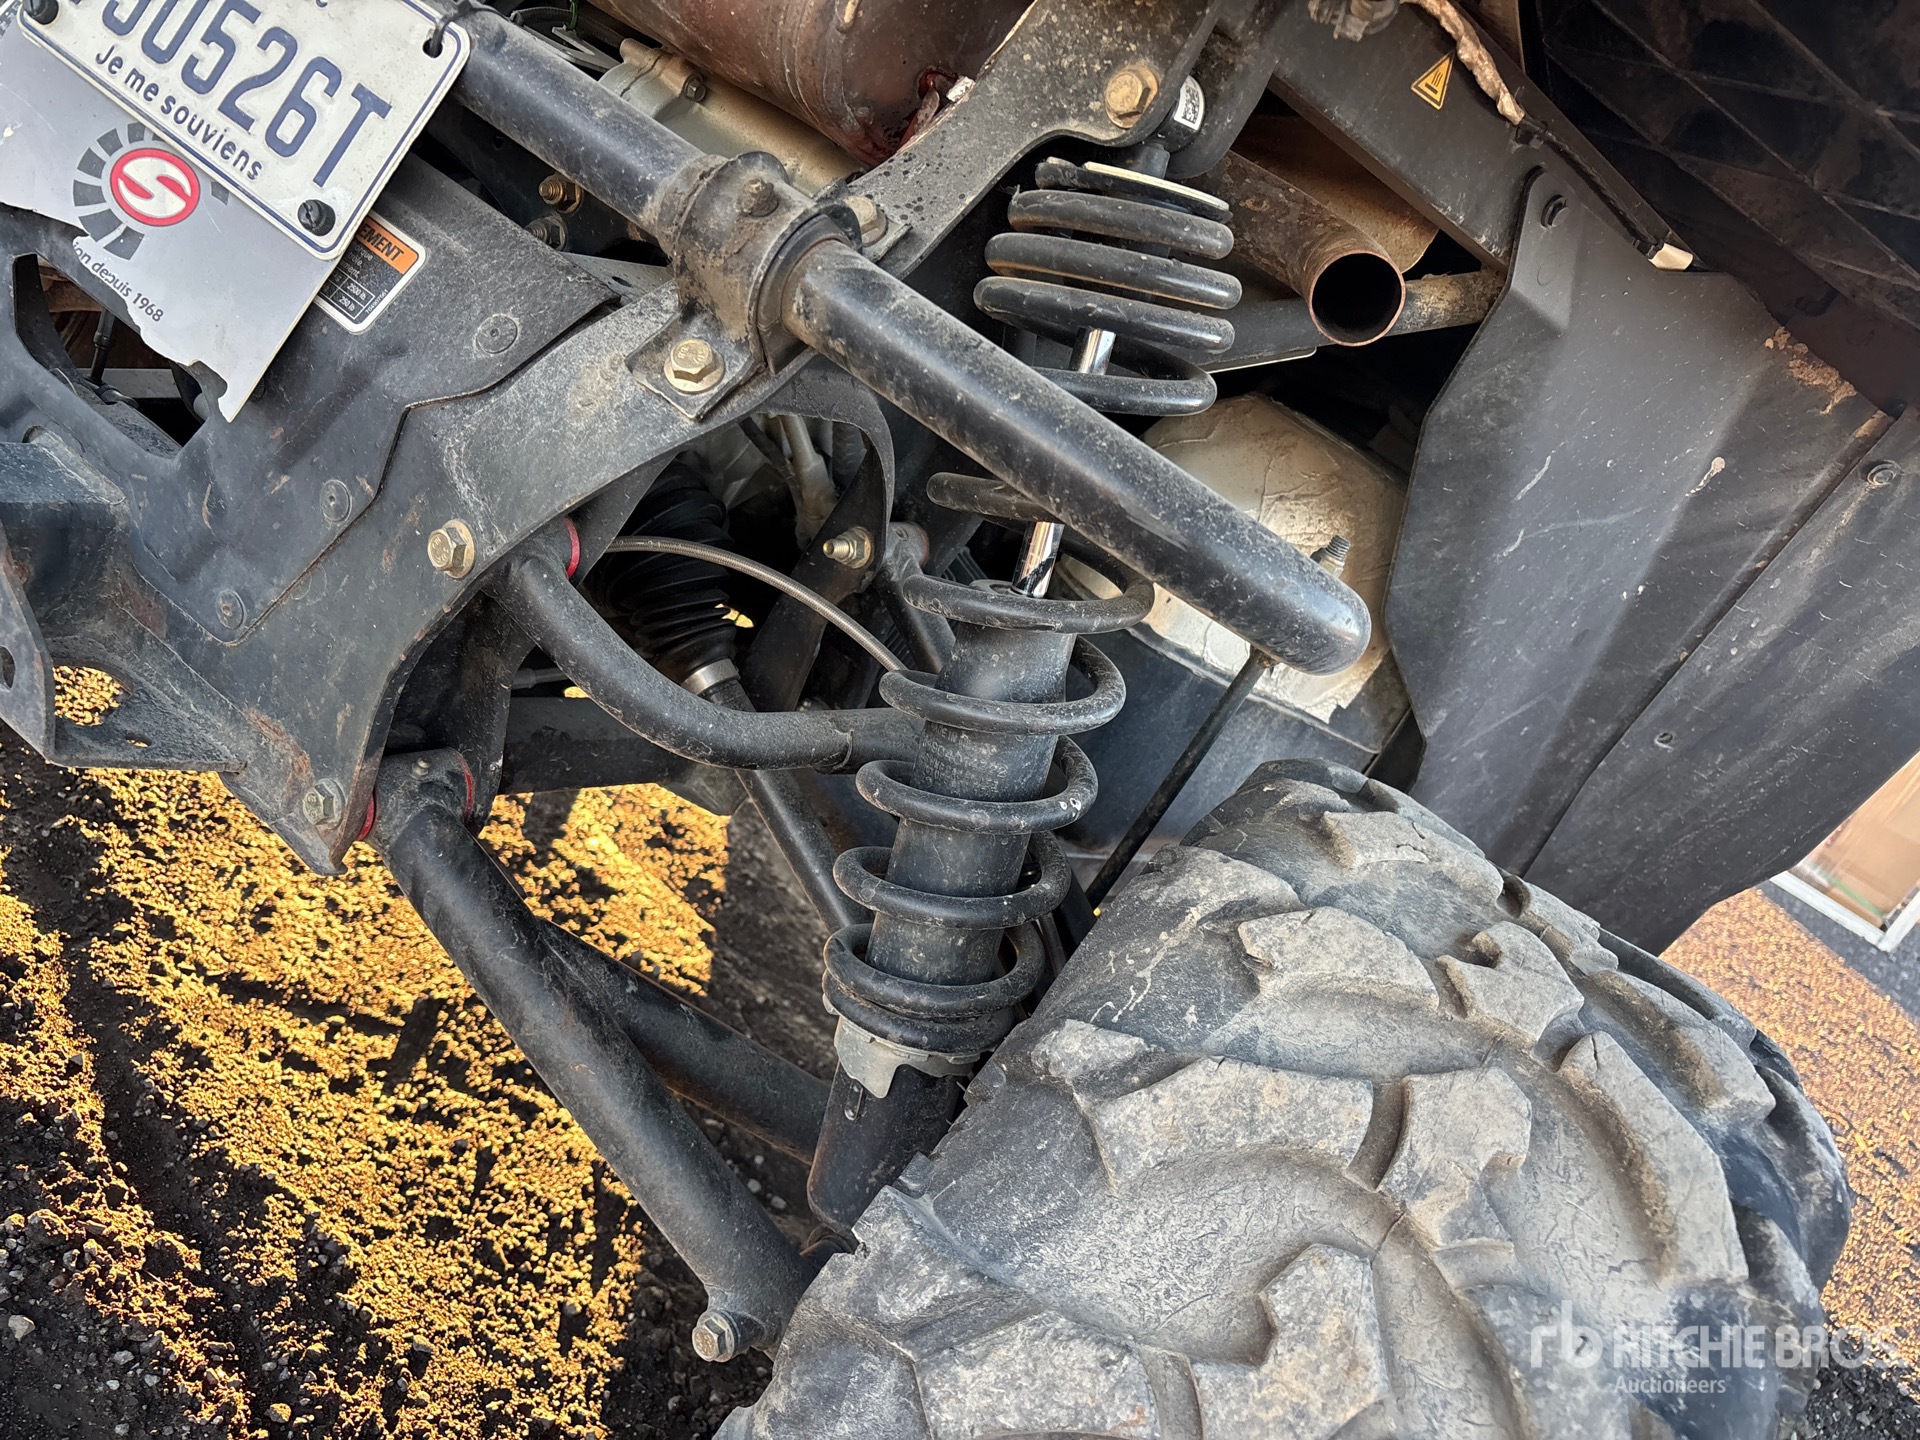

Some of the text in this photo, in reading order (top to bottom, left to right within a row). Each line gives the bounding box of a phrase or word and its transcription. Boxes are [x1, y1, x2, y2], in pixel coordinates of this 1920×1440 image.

[95, 44, 263, 180] Je me souviens
[358, 222, 404, 261] EMENT
[133, 292, 164, 322] 1968
[339, 295, 350, 307] 250
